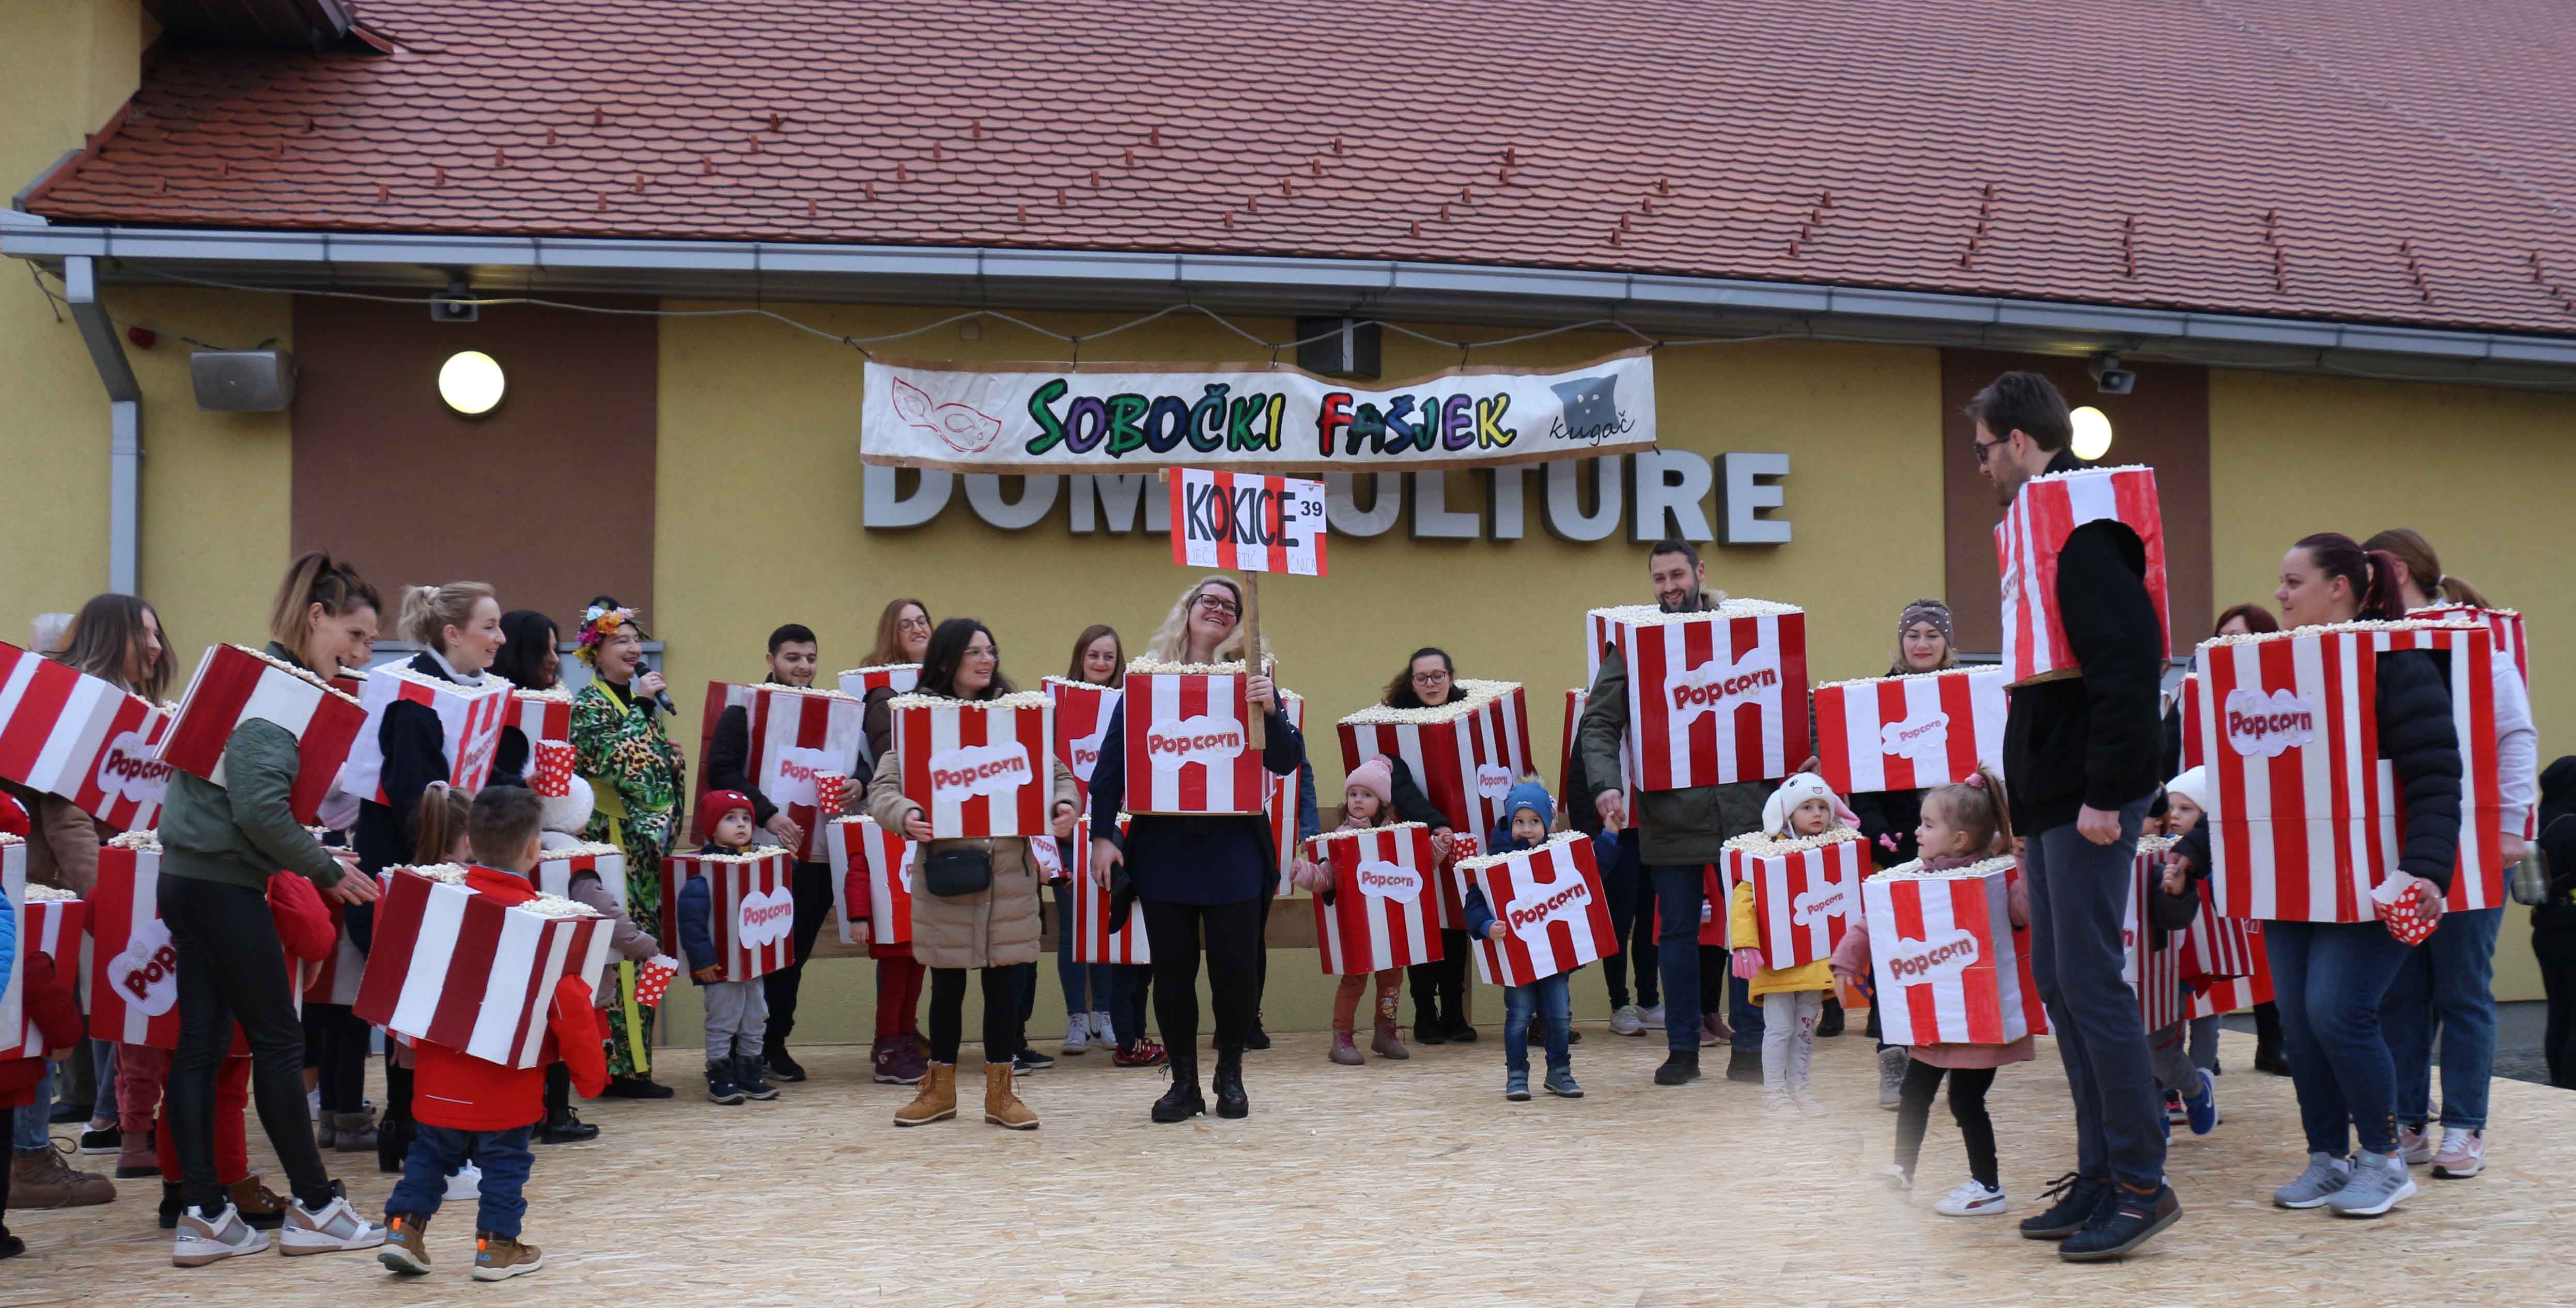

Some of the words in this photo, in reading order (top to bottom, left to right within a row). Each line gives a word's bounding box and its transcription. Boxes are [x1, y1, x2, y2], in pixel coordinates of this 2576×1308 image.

[1026, 378, 1286, 458] SOBOČKI
[1315, 391, 1517, 458] FAŠJEK
[1548, 411, 1636, 447] kugač
[863, 463, 1172, 535] DOM
[1318, 448, 1792, 545] ULTURE
[1300, 500, 1323, 517] 39
[1186, 482, 1299, 548] KOKICE
[1673, 668, 1777, 710] Popcorn
[1899, 720, 1942, 742] Popcorn
[2228, 711, 2313, 740] Popcorn
[1149, 732, 1240, 755] Popcorn
[933, 756, 1025, 790] Popcorn
[1480, 773, 1508, 789] Popcorn
[1361, 870, 1414, 888] Popcorn
[743, 902, 792, 927] Popcorn
[1511, 883, 1586, 930] Popcorn
[1807, 892, 1843, 915] Popcorn
[1889, 939, 1974, 980] Popcorn
